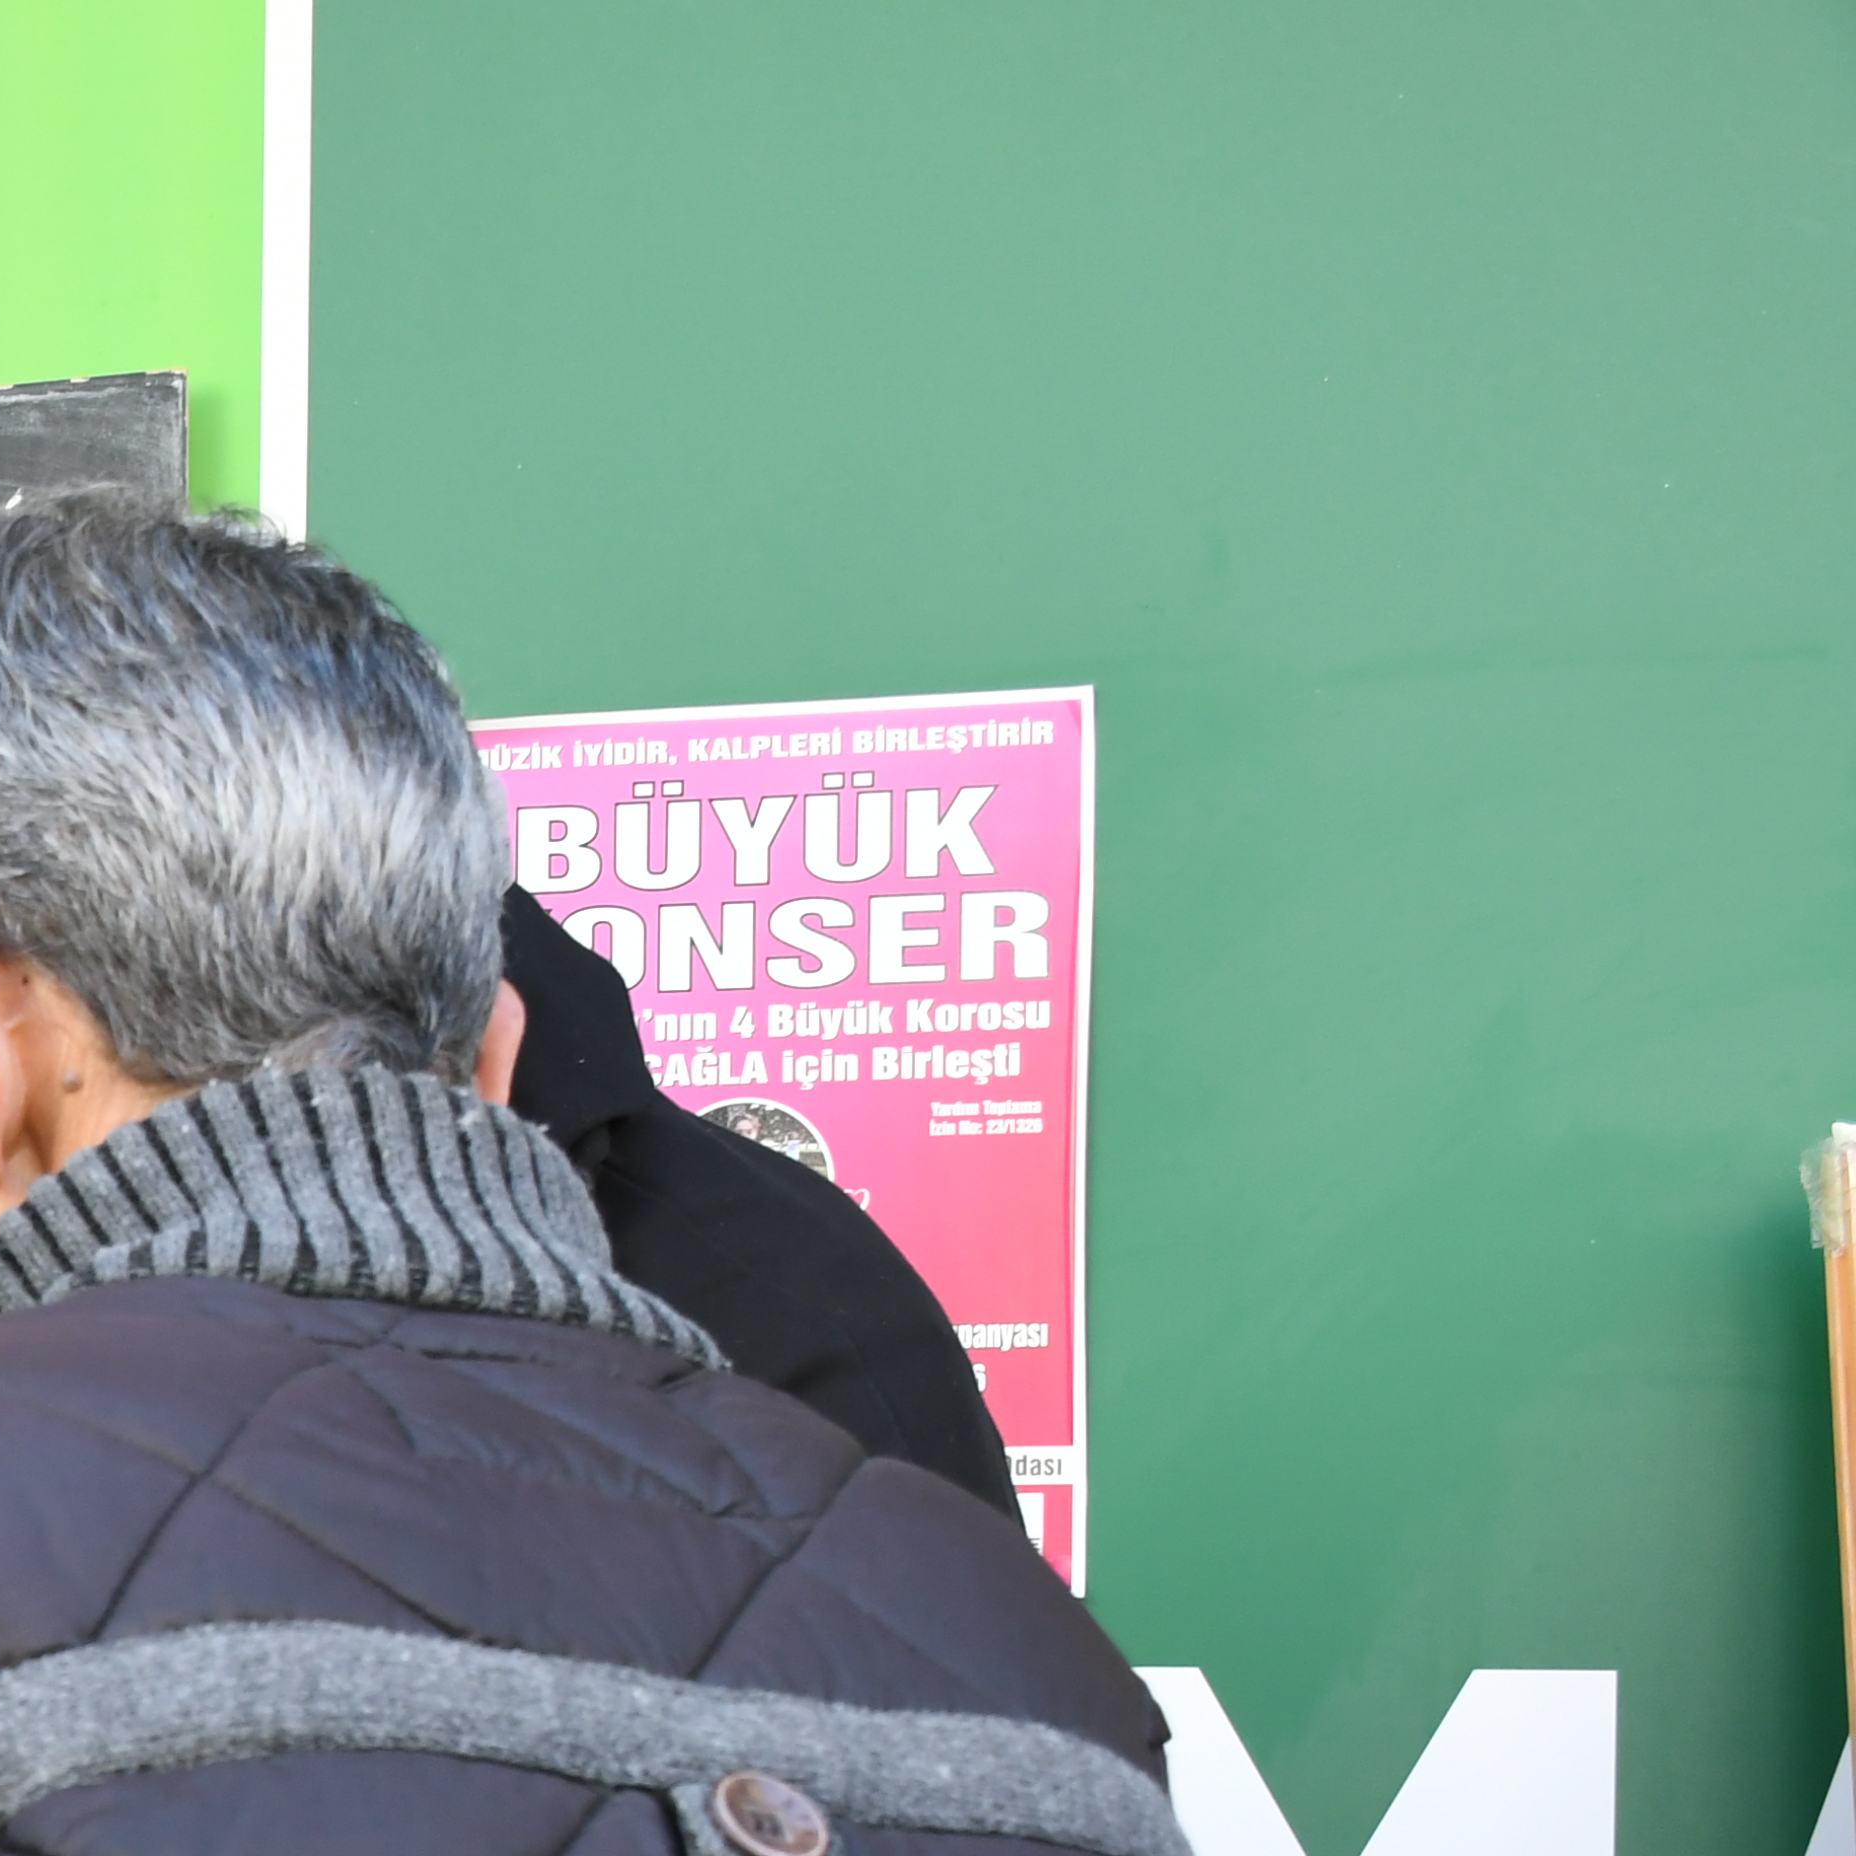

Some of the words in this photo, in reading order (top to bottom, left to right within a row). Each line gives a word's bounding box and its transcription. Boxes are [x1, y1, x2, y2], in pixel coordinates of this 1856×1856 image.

[573, 737, 678, 768] İYİDİR,
[688, 728, 842, 764] KALPLERİ
[853, 719, 1055, 756] BİRLEŞTİRİR
[516, 771, 999, 894] BÜYÜK
[545, 890, 1051, 994] ONSER
[729, 1006, 756, 1040] 4
[767, 1001, 893, 1040] Büyük
[906, 1000, 1051, 1034] Korosu
[783, 1048, 858, 1090] için
[873, 1042, 1022, 1085] Birleşti
[982, 1099, 1042, 1117] Toplama
[953, 1323, 1050, 1352] panyası
